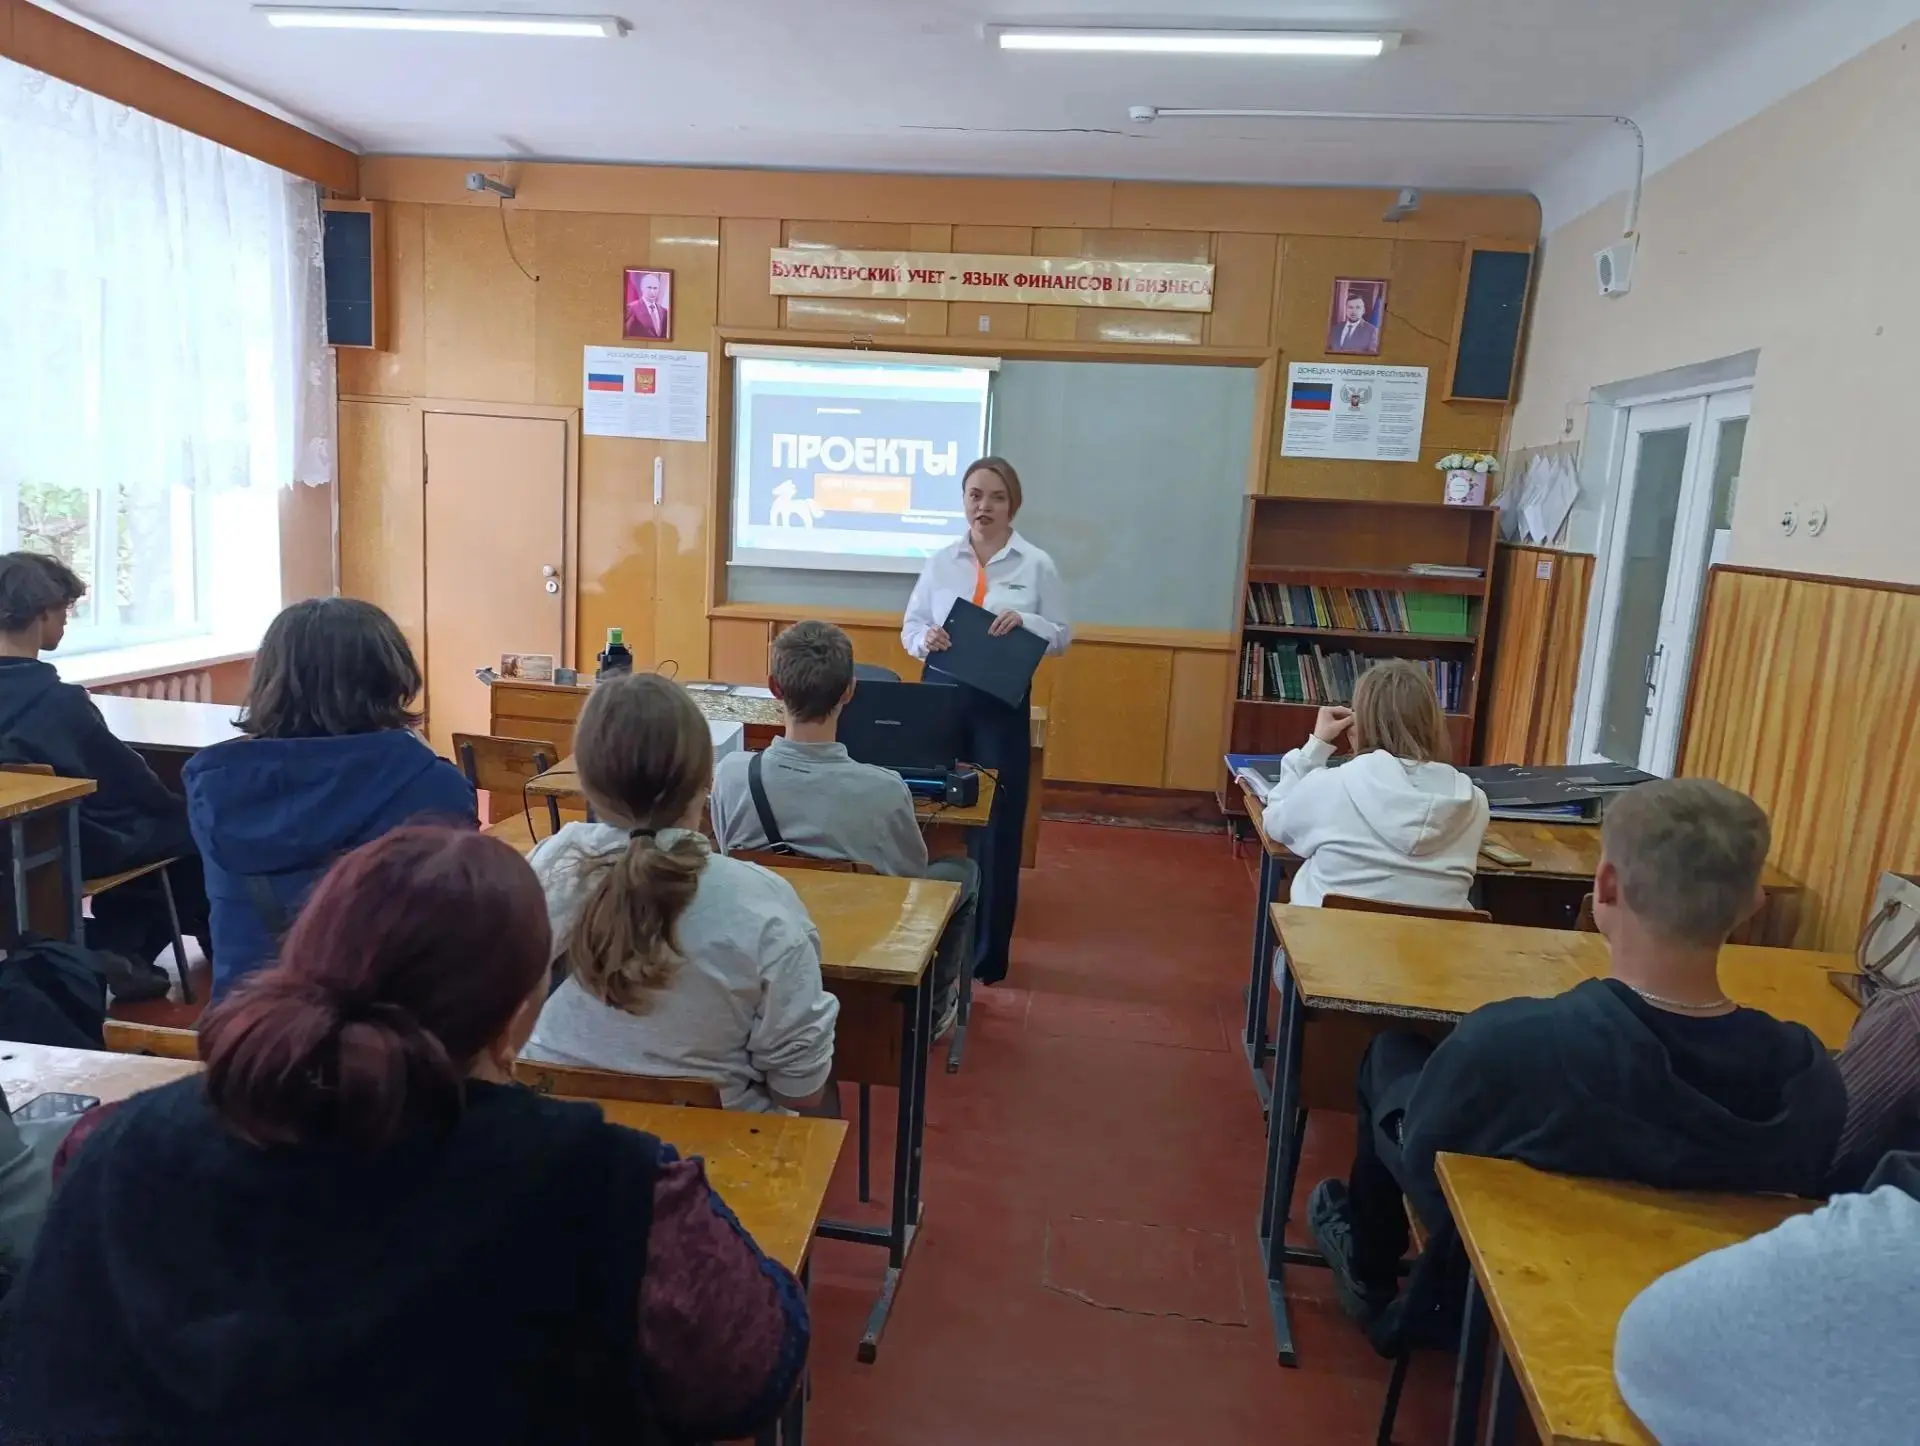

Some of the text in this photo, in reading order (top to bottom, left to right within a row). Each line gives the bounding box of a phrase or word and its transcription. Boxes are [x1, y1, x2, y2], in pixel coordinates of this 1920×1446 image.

[772, 260, 901, 282] БУХГАЛТЕРСКИЙ
[907, 268, 944, 285] УЧЕТ
[962, 270, 1009, 288] ЯЗЫК
[1013, 272, 1112, 292] ФИНАНСОВ
[1135, 278, 1212, 295] БИЗНЕСА
[772, 432, 958, 477] ПРОЕКТЫ
